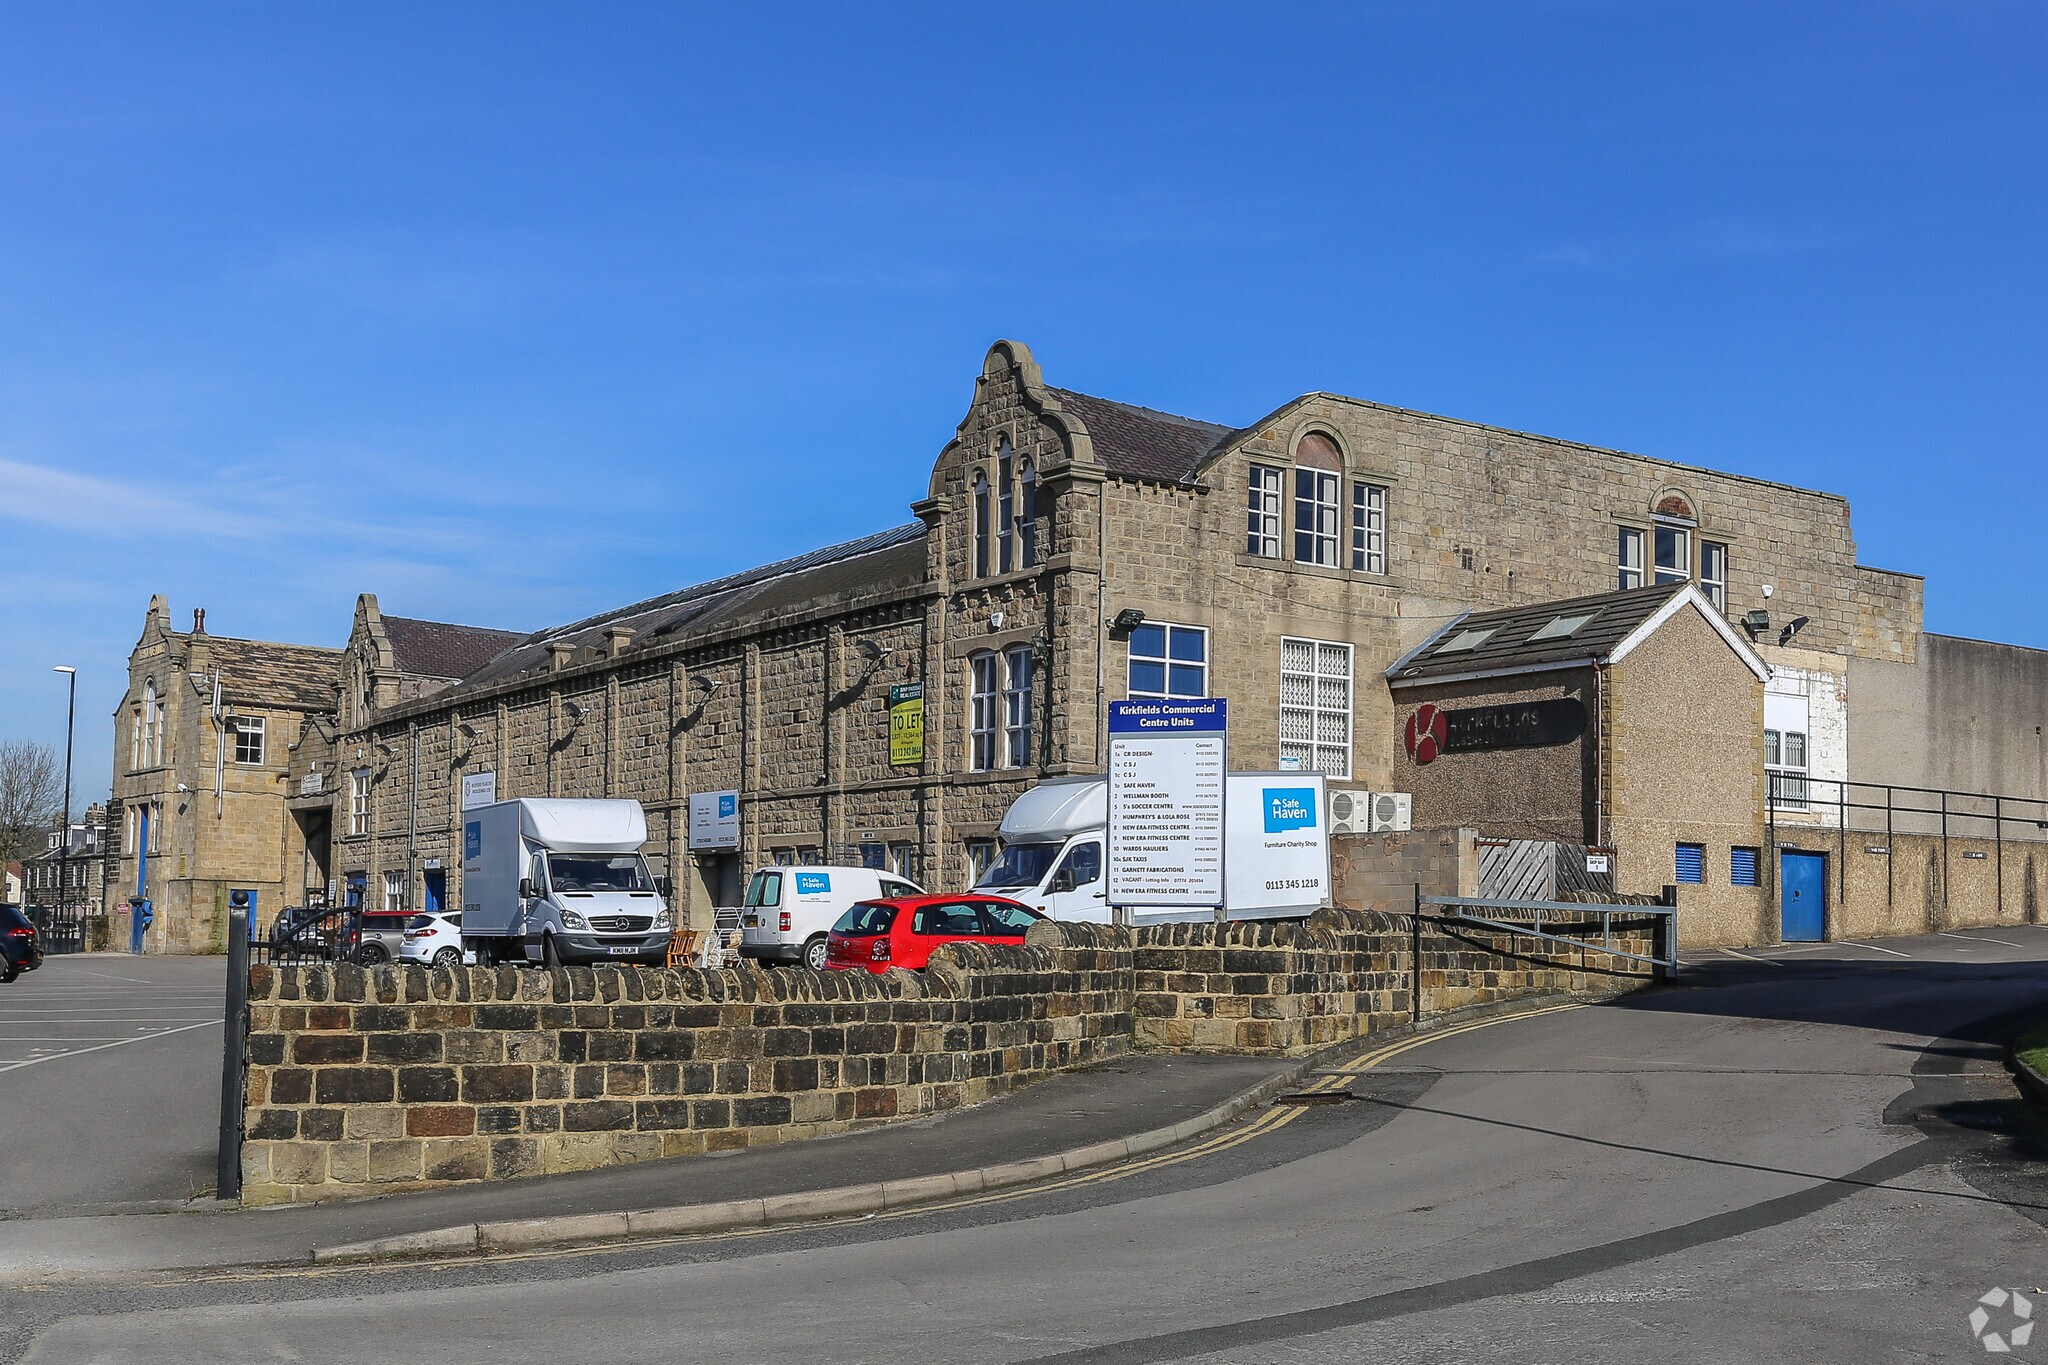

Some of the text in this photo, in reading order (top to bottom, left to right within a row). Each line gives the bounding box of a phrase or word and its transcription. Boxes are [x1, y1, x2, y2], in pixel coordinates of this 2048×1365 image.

[1120, 704, 1215, 715] Kirkfields Commercial
[893, 714, 920, 730] TO LET
[1140, 717, 1194, 727] Centre Units
[1282, 798, 1299, 808] Safe
[1273, 806, 1307, 819] Haven
[1266, 879, 1319, 890] 0113 345 1218
